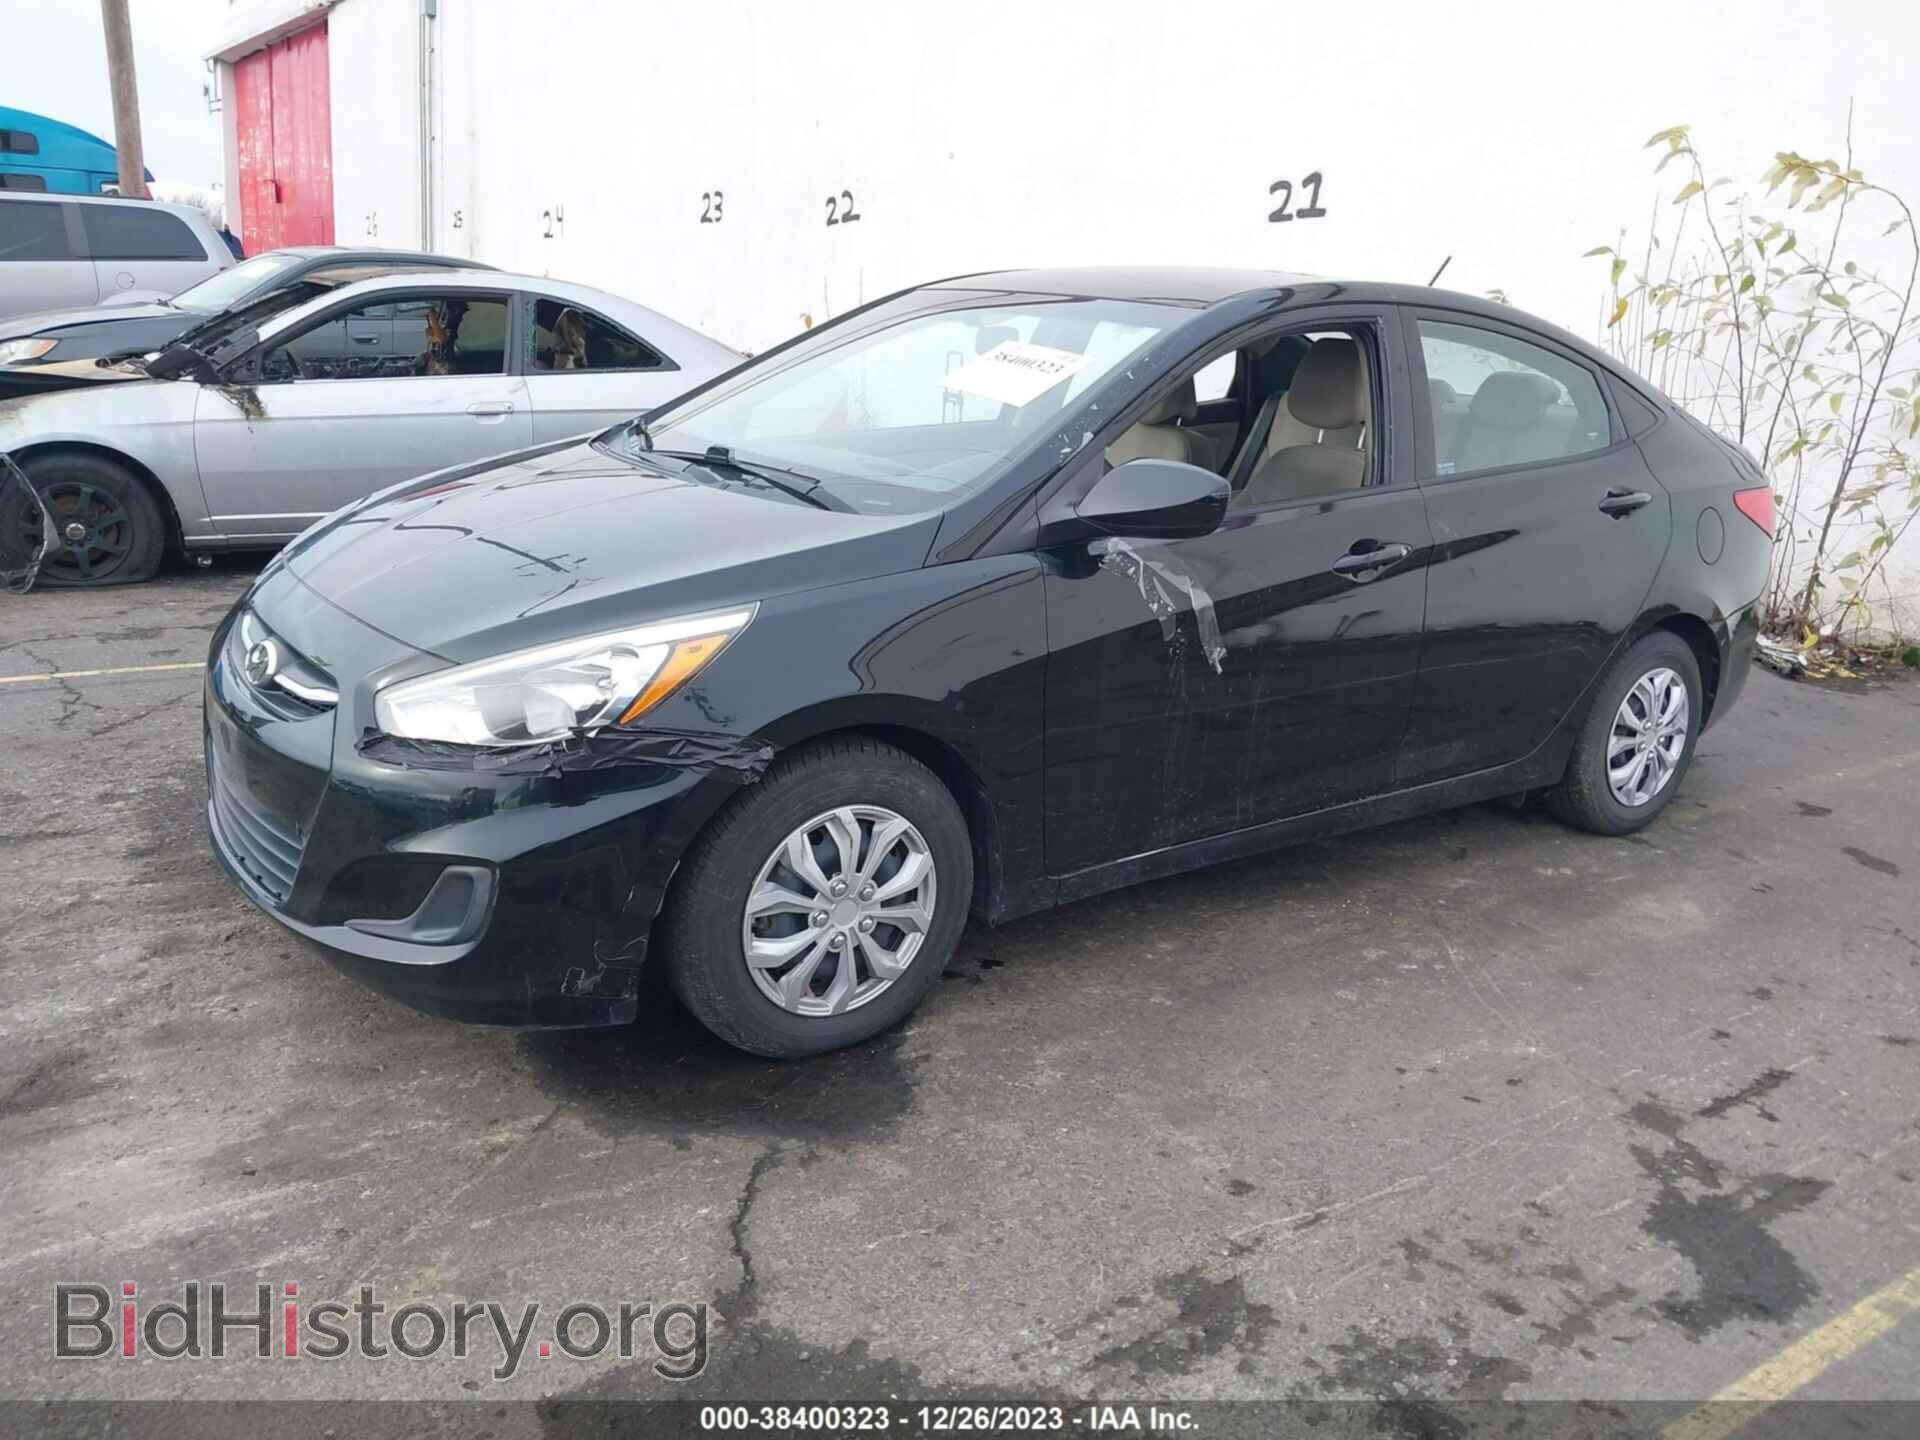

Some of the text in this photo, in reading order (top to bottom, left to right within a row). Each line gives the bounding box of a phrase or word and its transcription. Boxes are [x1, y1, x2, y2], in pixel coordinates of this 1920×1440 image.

[700, 190, 724, 224] 23
[825, 189, 861, 227] 22
[1268, 171, 1327, 223] 21
[543, 203, 565, 239] 24
